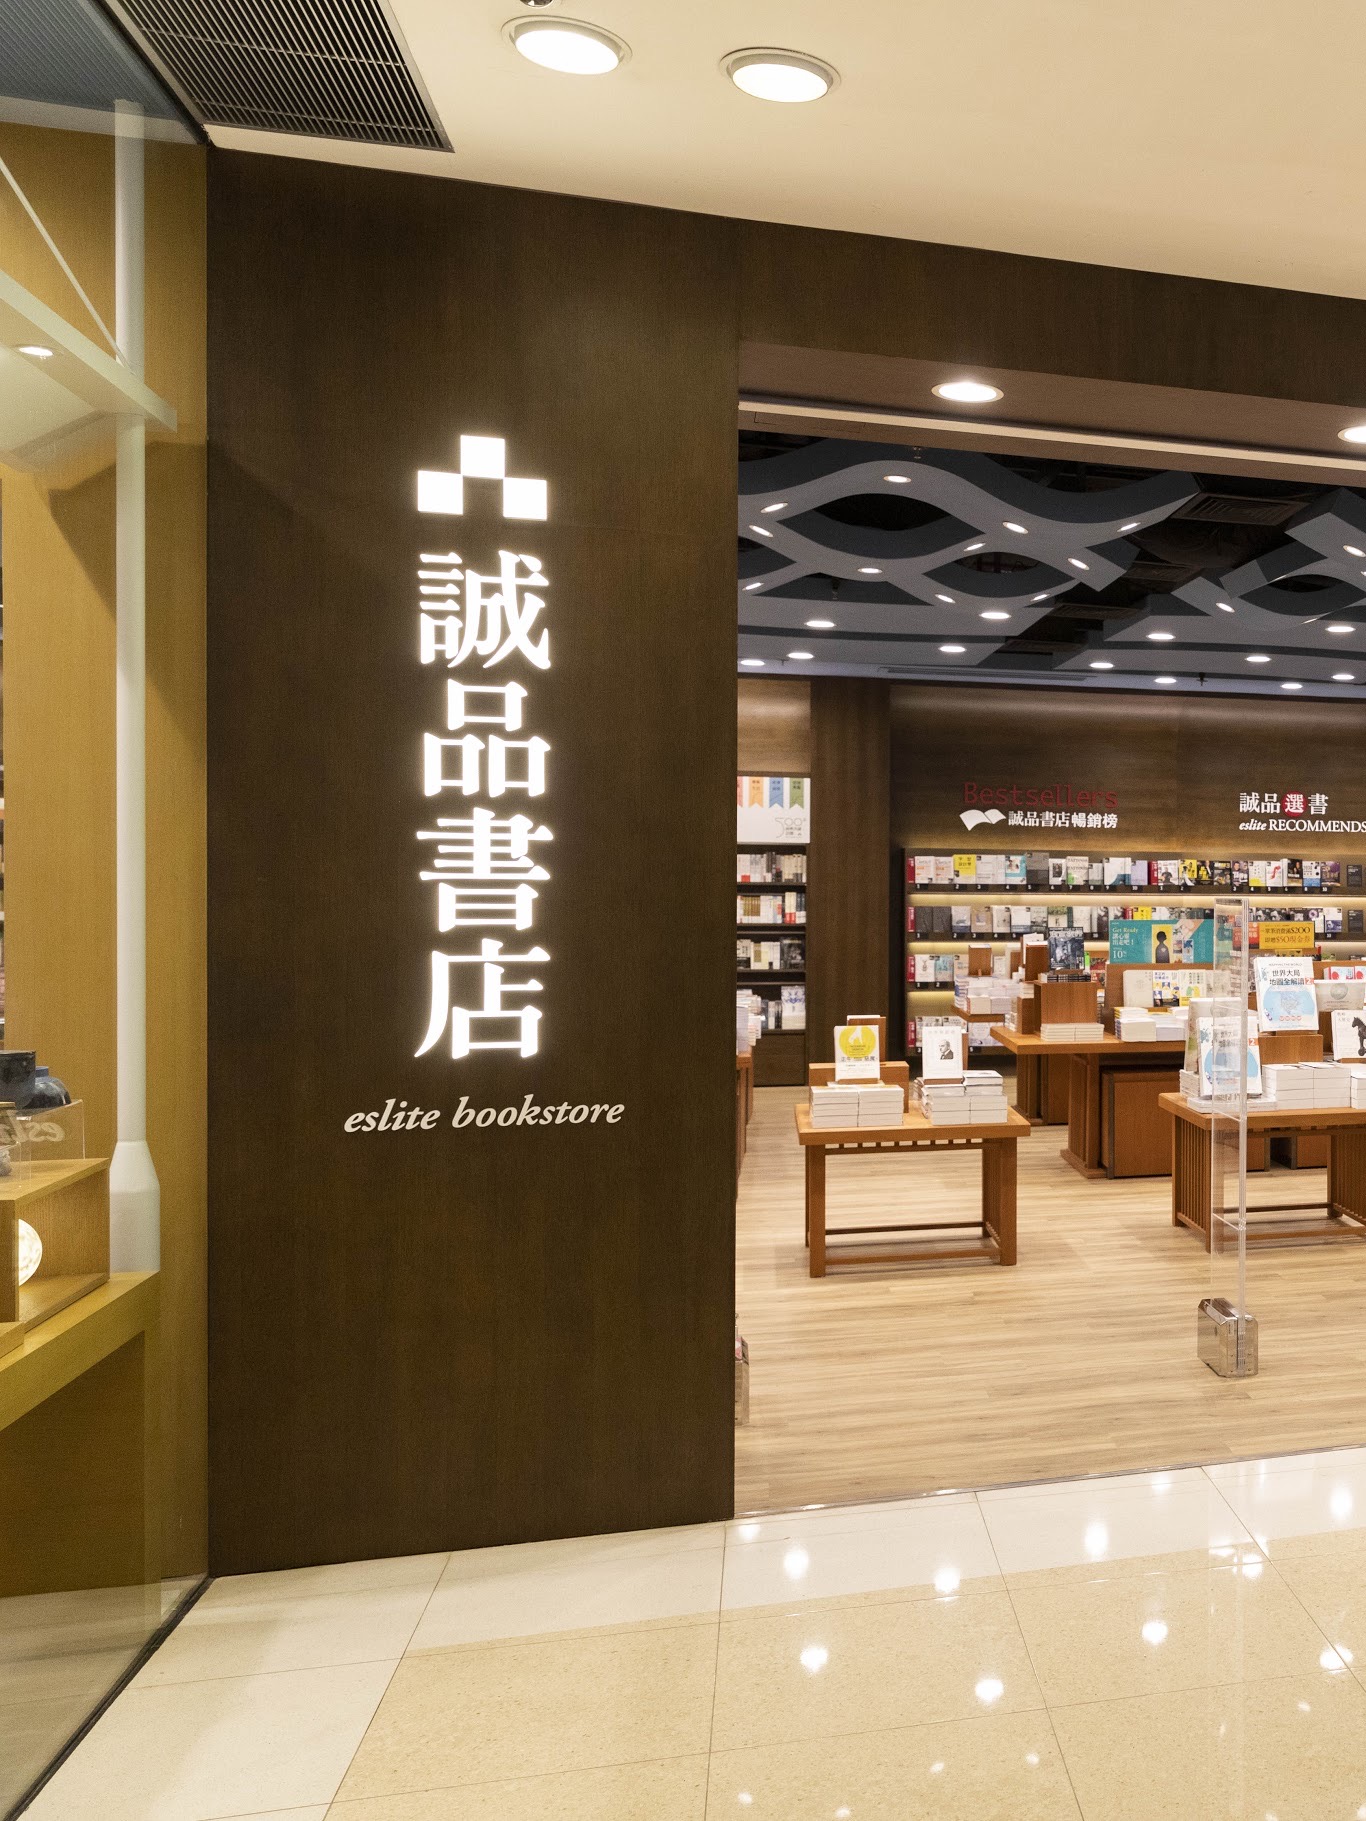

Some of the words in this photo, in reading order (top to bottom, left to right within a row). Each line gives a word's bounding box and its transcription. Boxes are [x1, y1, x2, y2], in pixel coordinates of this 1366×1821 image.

[415, 549, 554, 1060] 誠品書店
[963, 782, 1118, 808] Bestsellers
[1239, 792, 1329, 815] 誠品選書
[1008, 810, 1118, 829] 誠品書店暢銷榜
[1239, 818, 1268, 831] eslite
[344, 1098, 441, 1132] eslite
[452, 1094, 625, 1128] bookstore
